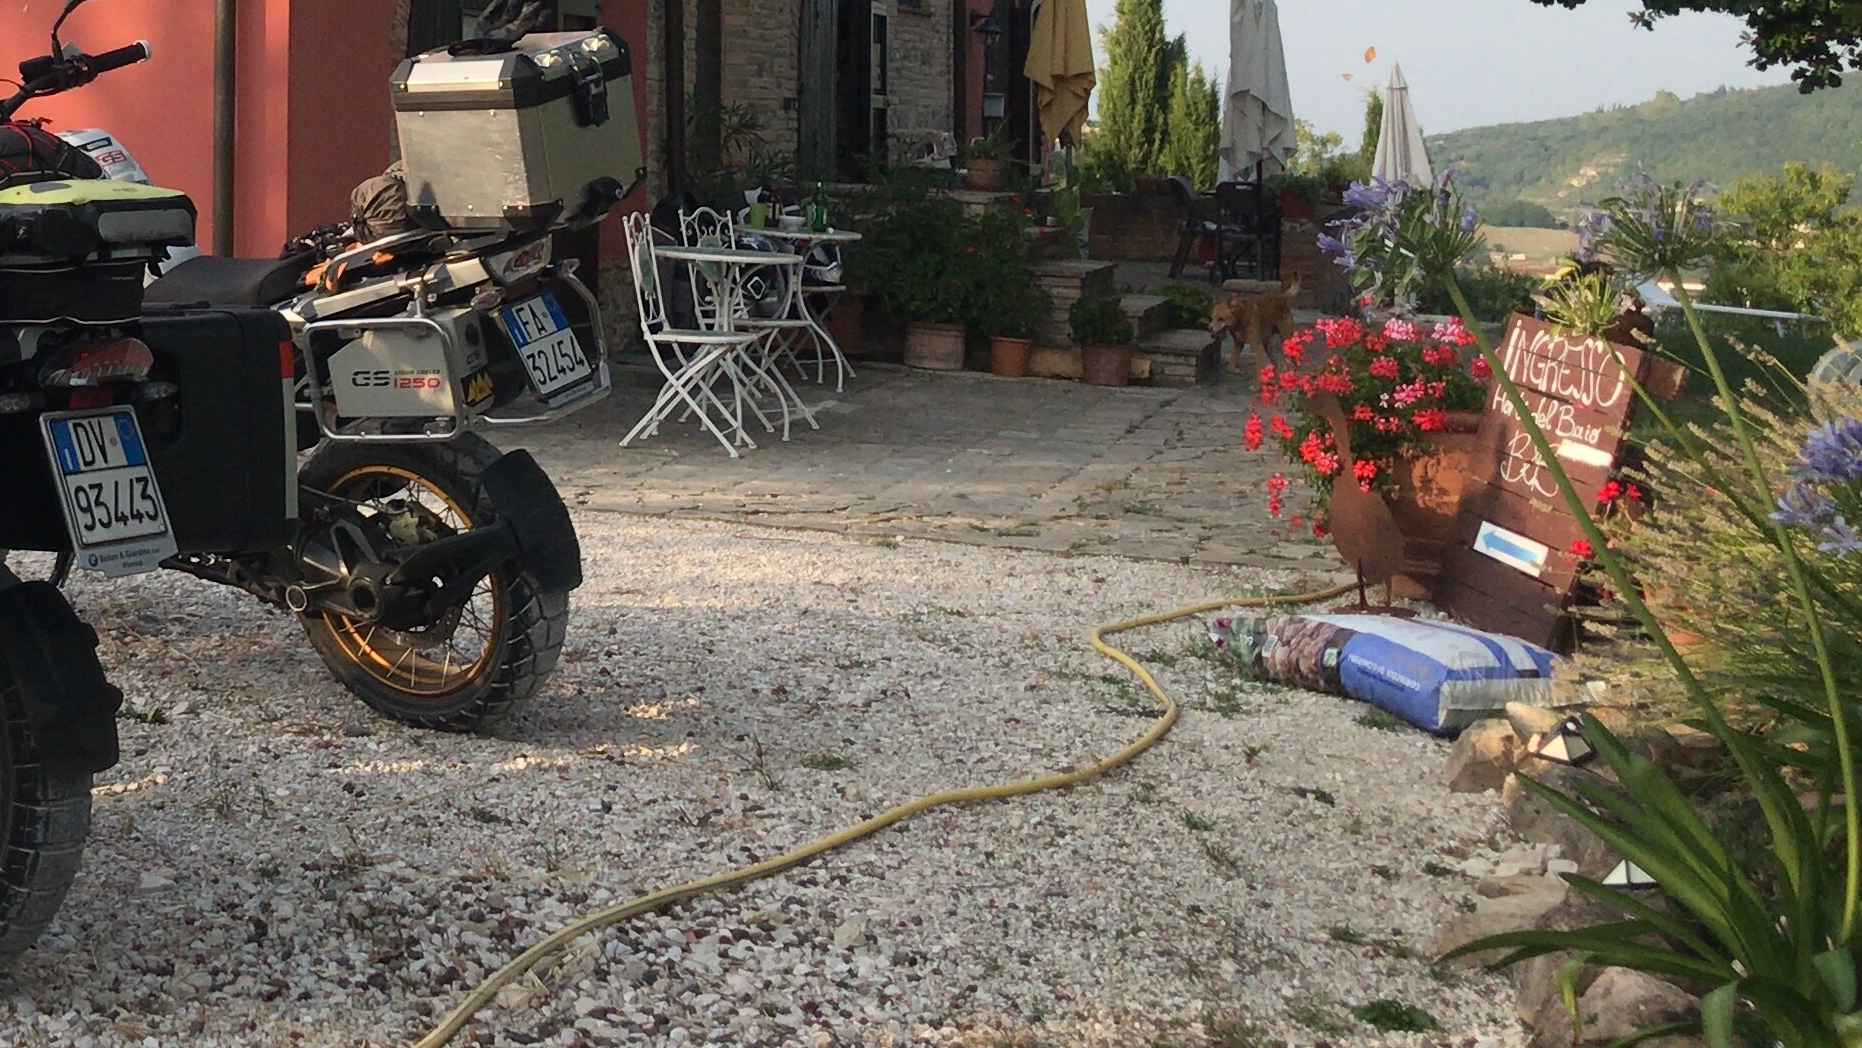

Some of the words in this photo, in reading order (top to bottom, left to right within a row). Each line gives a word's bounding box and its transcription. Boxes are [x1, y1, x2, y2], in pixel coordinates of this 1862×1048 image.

[516, 303, 547, 339] FA
[352, 370, 390, 387] GS
[394, 377, 441, 389] 1250
[526, 336, 585, 385] 32454
[72, 419, 109, 467] DV
[74, 476, 159, 532] 93443
